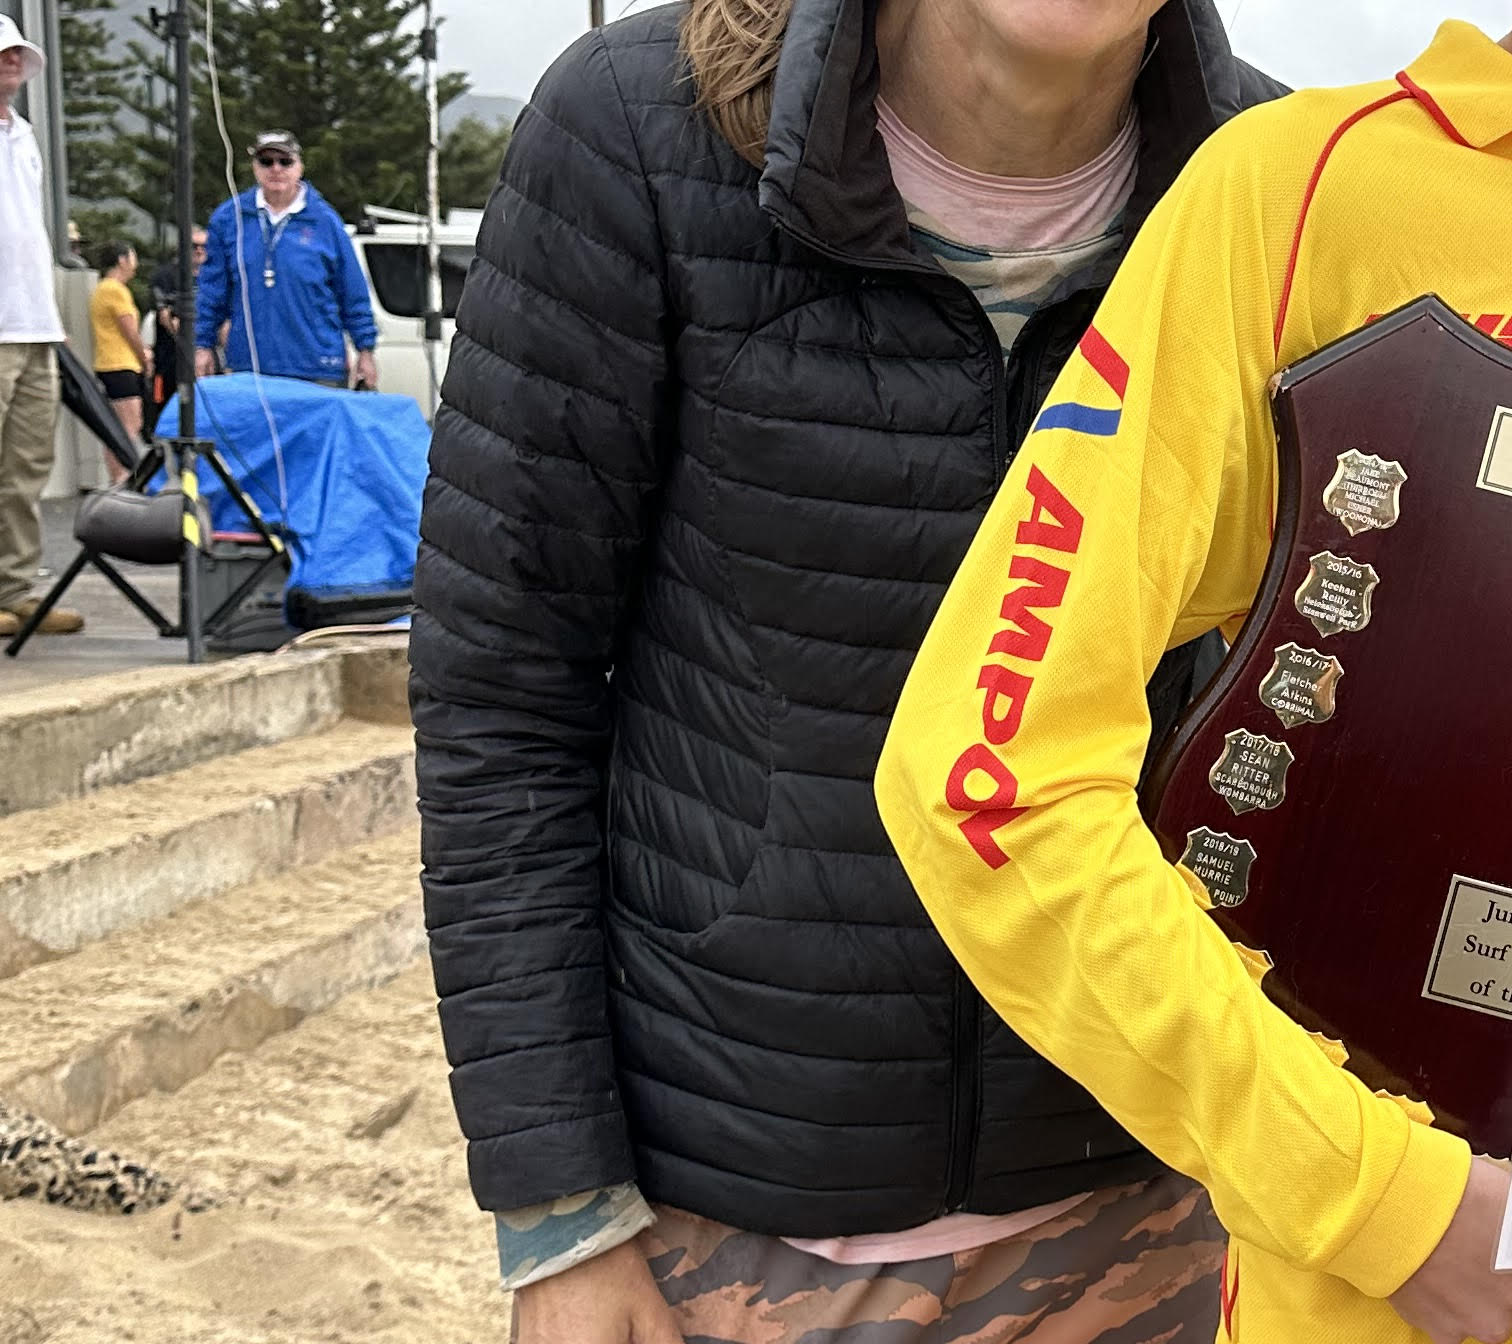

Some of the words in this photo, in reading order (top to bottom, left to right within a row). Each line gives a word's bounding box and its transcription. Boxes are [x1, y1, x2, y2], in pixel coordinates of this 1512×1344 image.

[1326, 560, 1363, 579] 2015/16
[945, 462, 1085, 871] AMPOL
[1288, 650, 1330, 670] 2016/17
[1280, 687, 1313, 706] Atkins
[1239, 734, 1281, 757] 2017/18
[1241, 750, 1271, 769] SEAN
[1231, 762, 1270, 784] RITTER
[1203, 836, 1240, 856] 2018/19
[1196, 852, 1235, 873] SAMUEL
[1193, 864, 1233, 885] MURRIE
[1213, 888, 1241, 905] POINT
[1463, 934, 1512, 962] Surf
[1469, 979, 1496, 997] of
